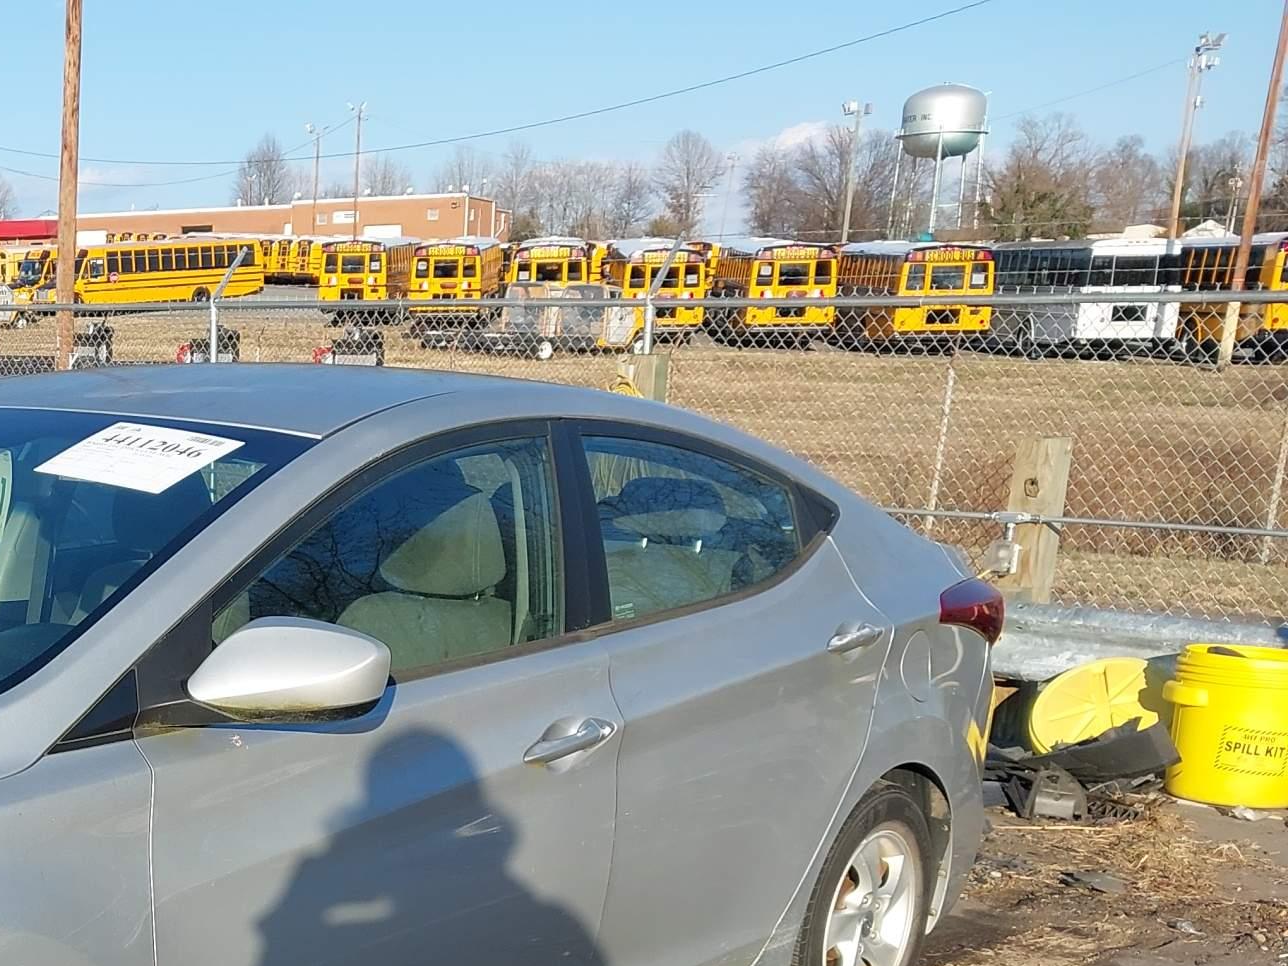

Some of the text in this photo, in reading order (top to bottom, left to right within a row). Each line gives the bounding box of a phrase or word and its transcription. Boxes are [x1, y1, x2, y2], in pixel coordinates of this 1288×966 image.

[927, 250, 974, 260] SCHOOL BUS
[103, 433, 208, 458] 44112046
[1225, 740, 1286, 759] SPILL KIT
